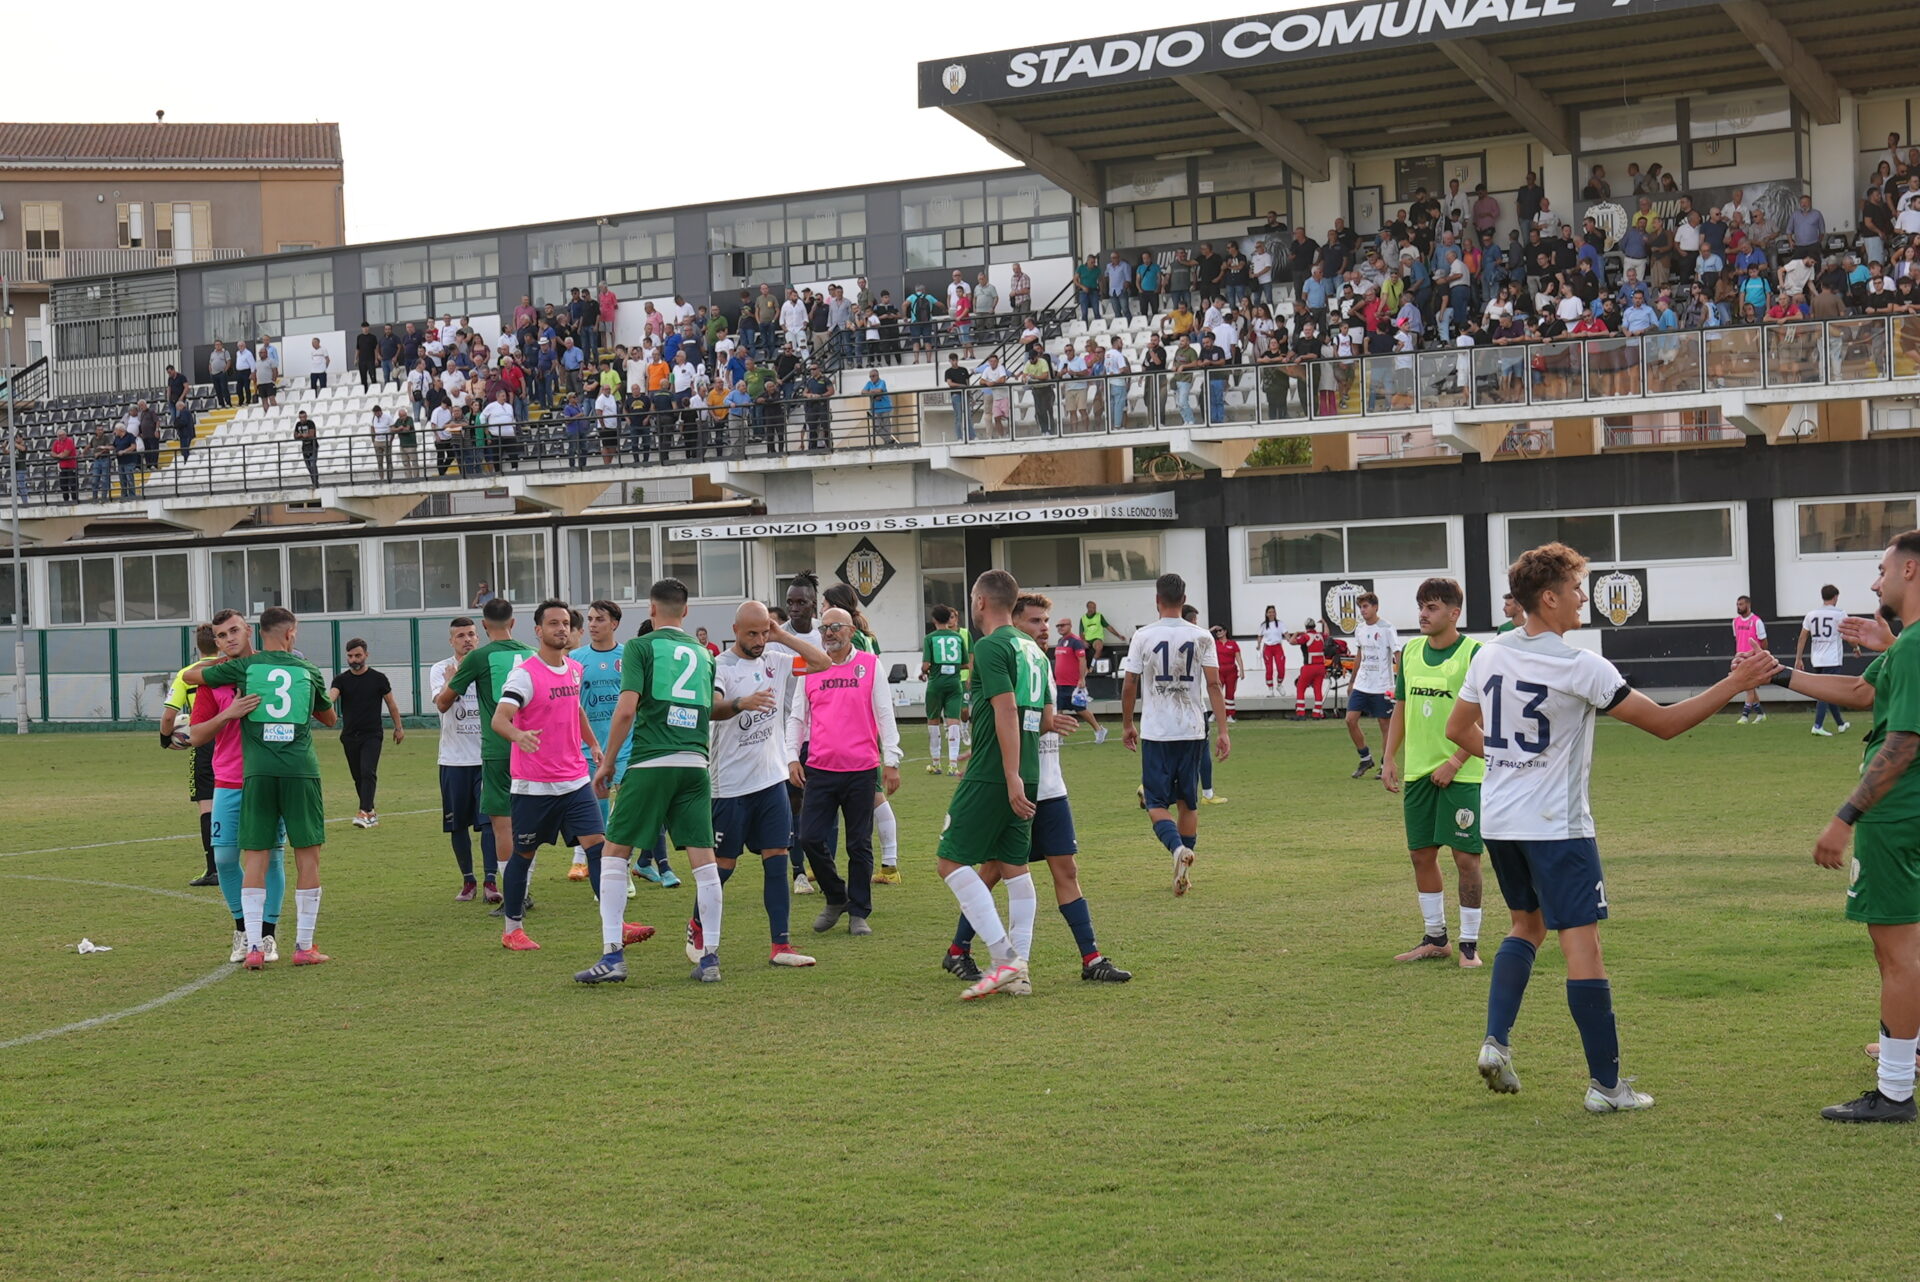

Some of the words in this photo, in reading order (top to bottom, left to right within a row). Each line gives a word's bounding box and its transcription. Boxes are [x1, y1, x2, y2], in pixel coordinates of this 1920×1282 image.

[1006, 31, 1205, 88] STADIO
[681, 528, 719, 538] S.S.
[727, 523, 817, 536] LEONZIO
[825, 520, 871, 531] 1909
[884, 518, 924, 529] S.S.
[933, 510, 1031, 526] LEONZIO
[1039, 507, 1089, 519] 1909
[1127, 507, 1157, 517] LEONZIO
[1158, 507, 1173, 517] 1909
[1811, 617, 1833, 637] 15
[937, 637, 959, 662] 13
[671, 645, 698, 700] 2
[1153, 641, 1194, 682] 11
[1027, 643, 1042, 703] 6
[265, 668, 292, 718] 3
[599, 694, 619, 702] EGE
[669, 708, 697, 720] ACQUA
[1423, 700, 1433, 717] 6
[1483, 674, 1550, 753] 13
[264, 725, 293, 735] ACQUA
[668, 719, 695, 727] AZZURRA
[211, 821, 221, 838] 2
